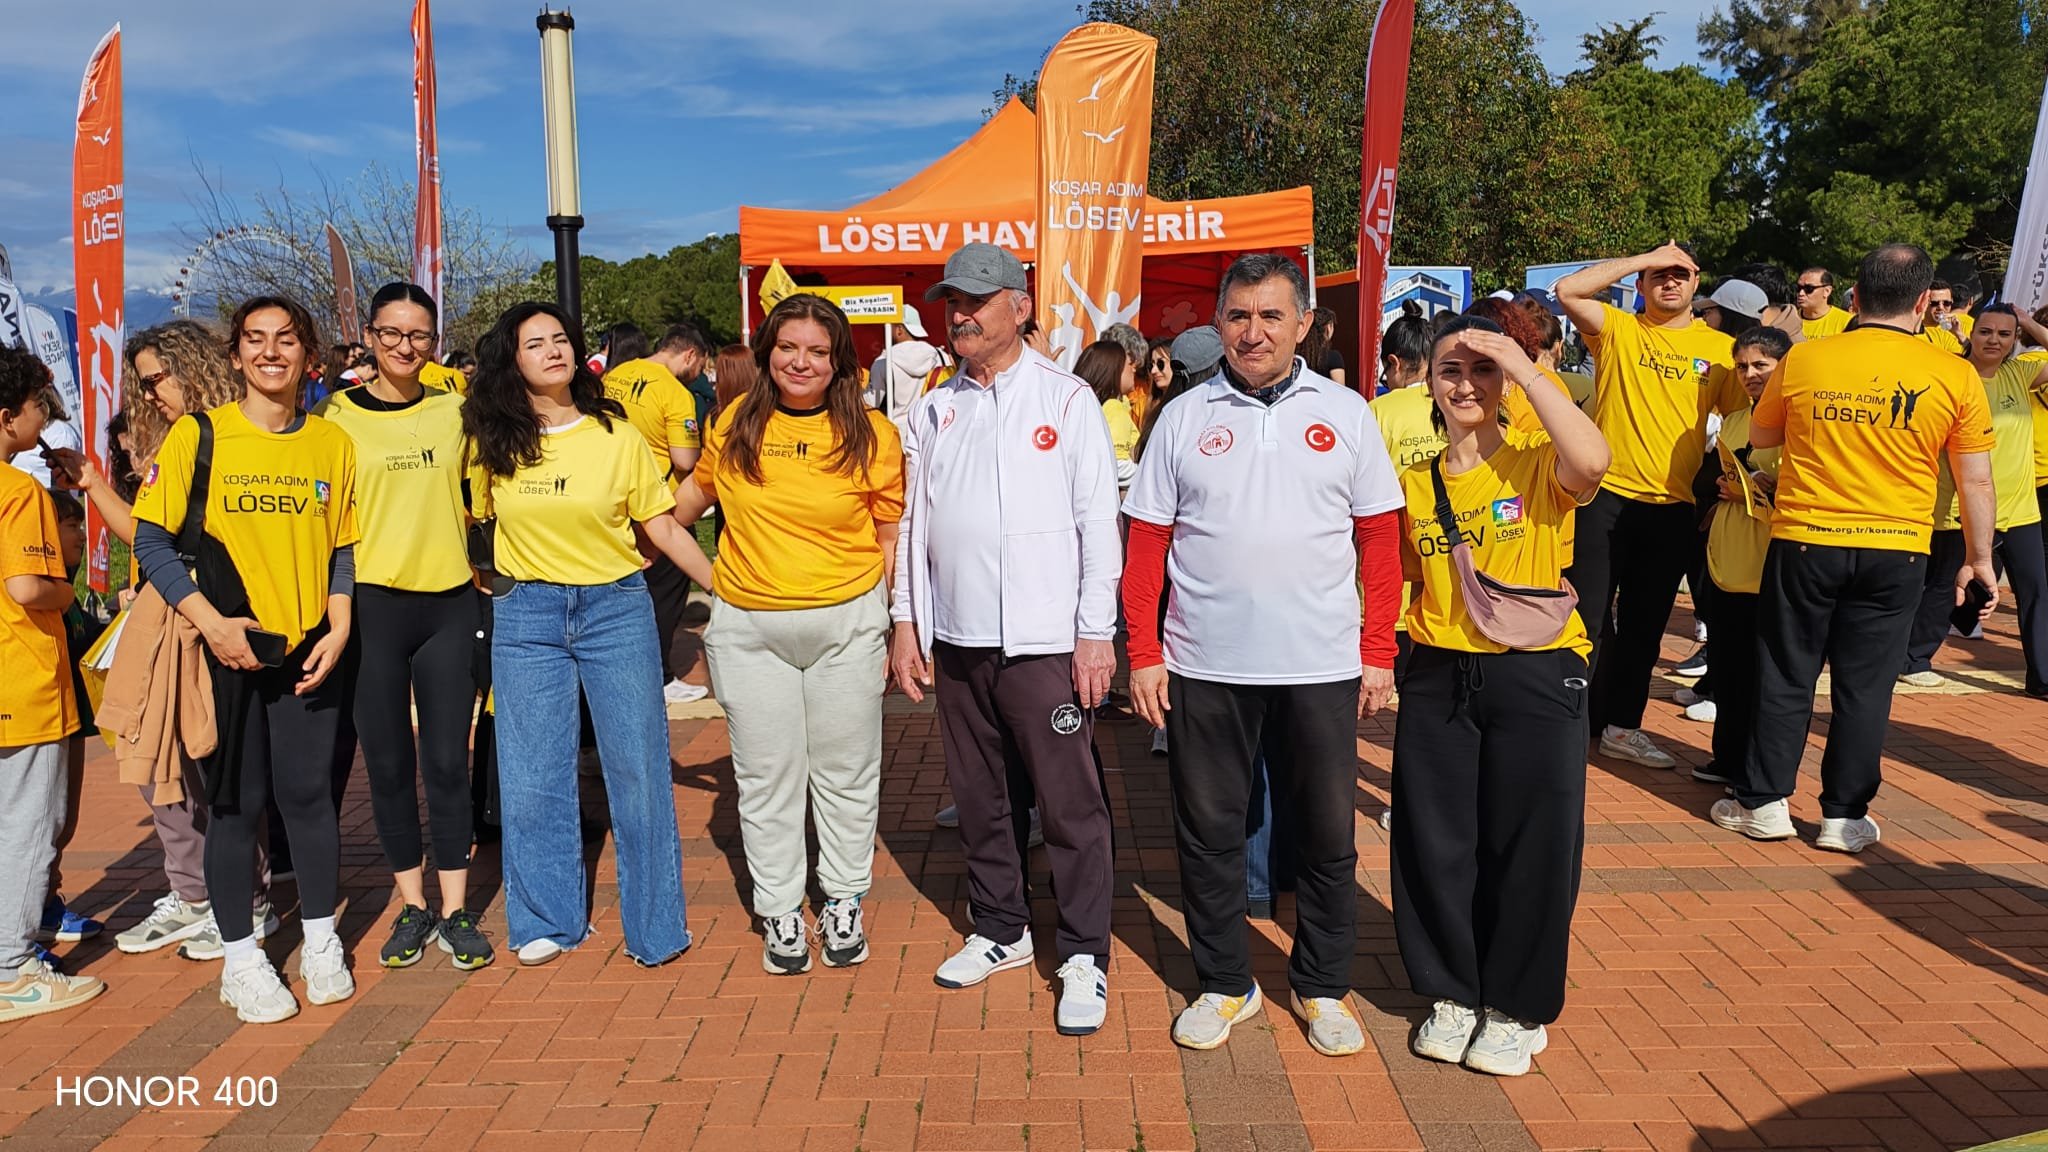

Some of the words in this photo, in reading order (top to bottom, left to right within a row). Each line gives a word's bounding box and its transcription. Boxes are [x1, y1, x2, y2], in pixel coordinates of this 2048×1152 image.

[1049, 180, 1101, 198] KOŞAR
[1106, 182, 1143, 198] ADIM
[1048, 201, 1140, 231] LÖSEV
[818, 217, 950, 253] LÖSEV
[863, 306, 895, 315] YAŞASIN
[1813, 390, 1852, 403] KOŞAR
[1855, 391, 1886, 405] ADIM
[1813, 404, 1881, 426] LÖSEV
[1400, 436, 1433, 447] KOŞAR
[387, 461, 420, 471] LÖSEV
[275, 475, 308, 487] ADIM
[518, 486, 550, 495] LÖSEV
[224, 490, 308, 514] LÖSEV
[1496, 527, 1525, 540] LÖSEV
